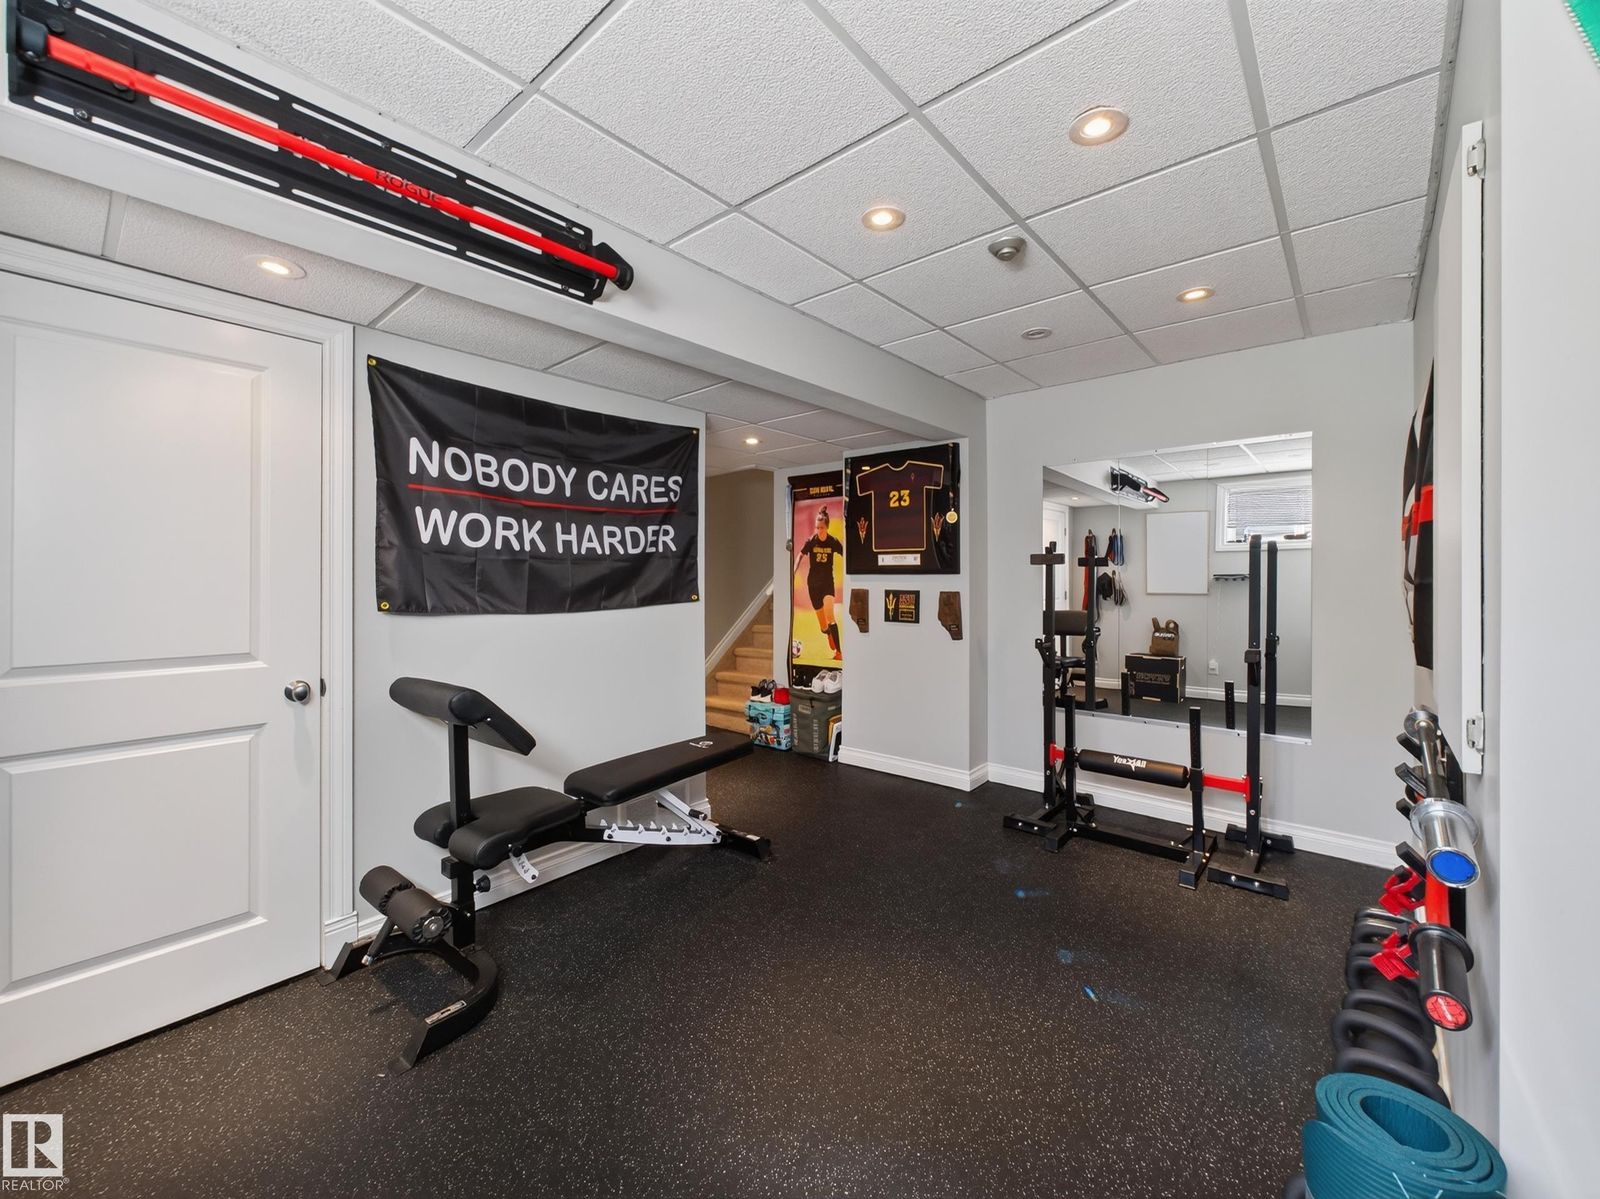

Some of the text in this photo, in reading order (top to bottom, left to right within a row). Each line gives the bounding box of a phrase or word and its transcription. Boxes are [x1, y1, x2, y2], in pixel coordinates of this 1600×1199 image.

[408, 436, 683, 504] NOBODY CARES
[889, 489, 911, 508] 23
[414, 505, 677, 555] WORK HARDER
